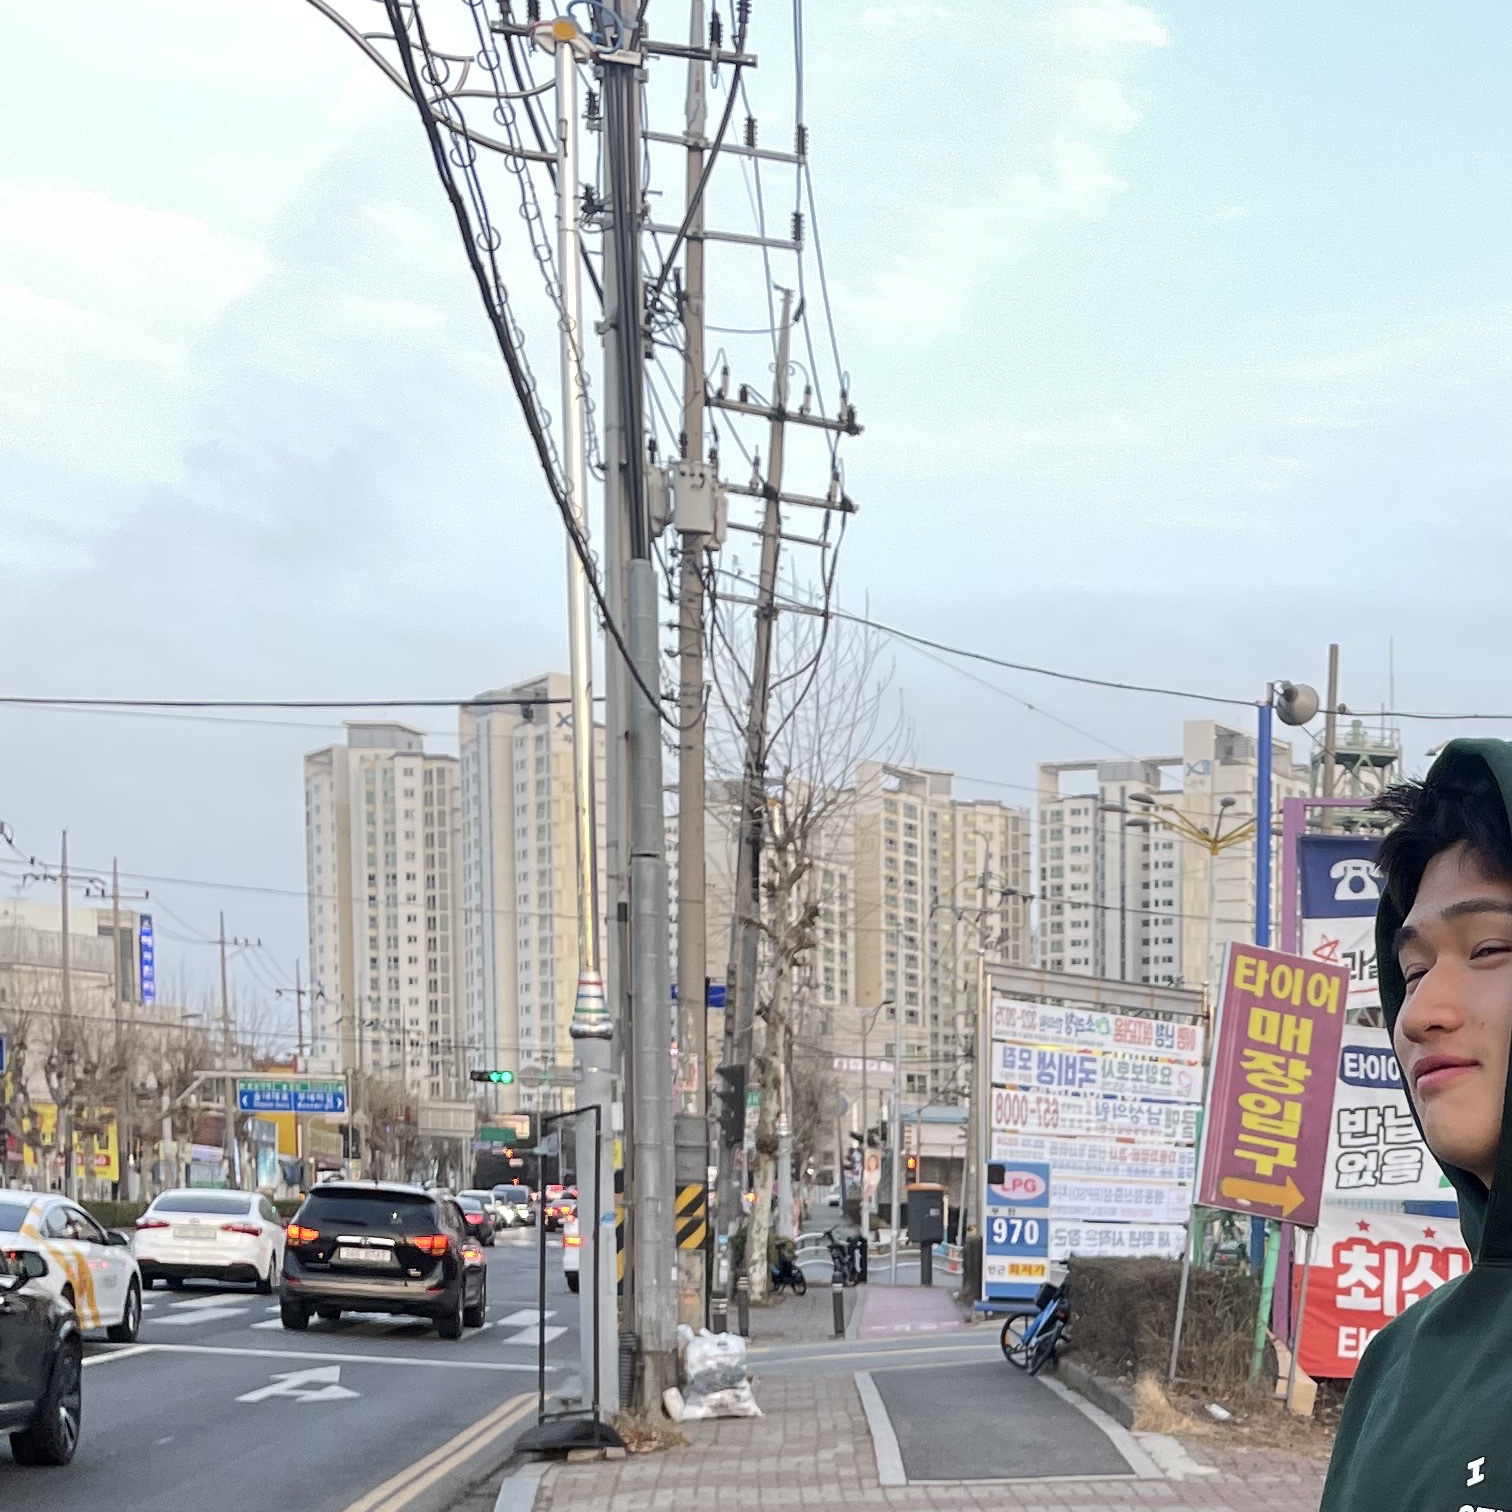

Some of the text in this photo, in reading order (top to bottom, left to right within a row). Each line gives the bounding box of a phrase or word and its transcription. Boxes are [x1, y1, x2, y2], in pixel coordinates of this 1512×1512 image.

[1234, 954, 1341, 1014] 타이어
[1234, 1006, 1314, 1177] 매장입구
[1336, 1146, 1424, 1189] 없음
[992, 1218, 1040, 1245] 970
[1337, 1326, 1378, 1360] 타
